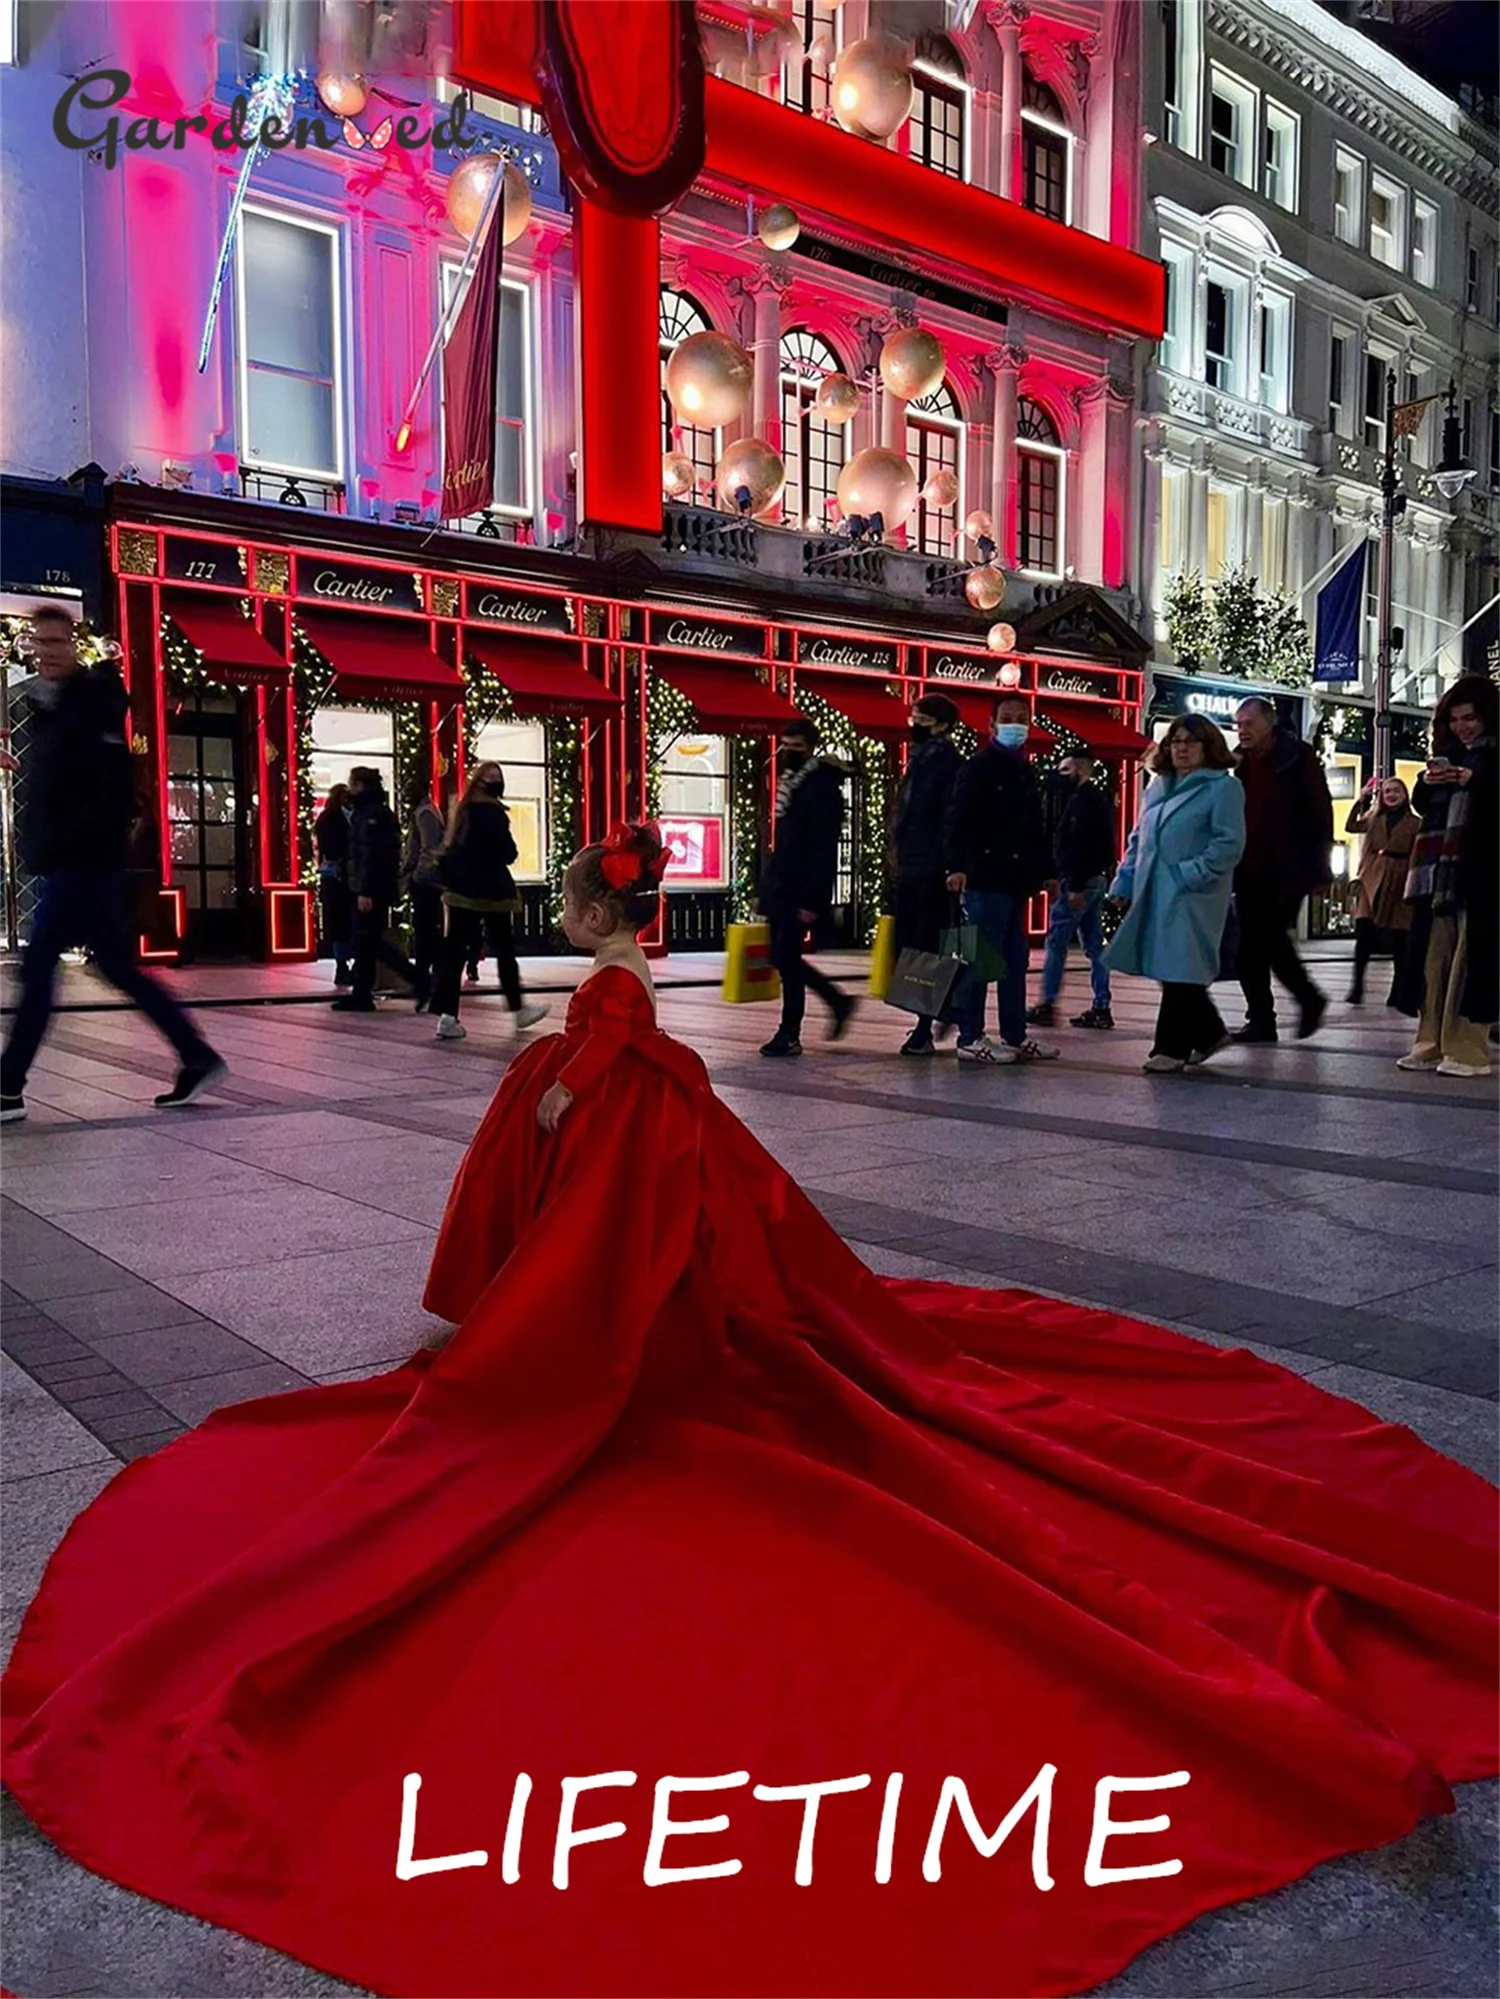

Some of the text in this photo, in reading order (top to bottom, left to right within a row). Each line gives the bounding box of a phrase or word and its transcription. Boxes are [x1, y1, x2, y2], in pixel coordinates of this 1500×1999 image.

[869, 263, 922, 291] Cartier
[45, 569, 71, 583] 178
[185, 561, 217, 579] 177
[313, 570, 393, 602] Cartier
[477, 593, 548, 623] Cartier
[666, 619, 734, 650] Cartier
[810, 638, 868, 667] Cartier
[935, 655, 985, 681] Cartier
[1047, 669, 1093, 694] Cartier
